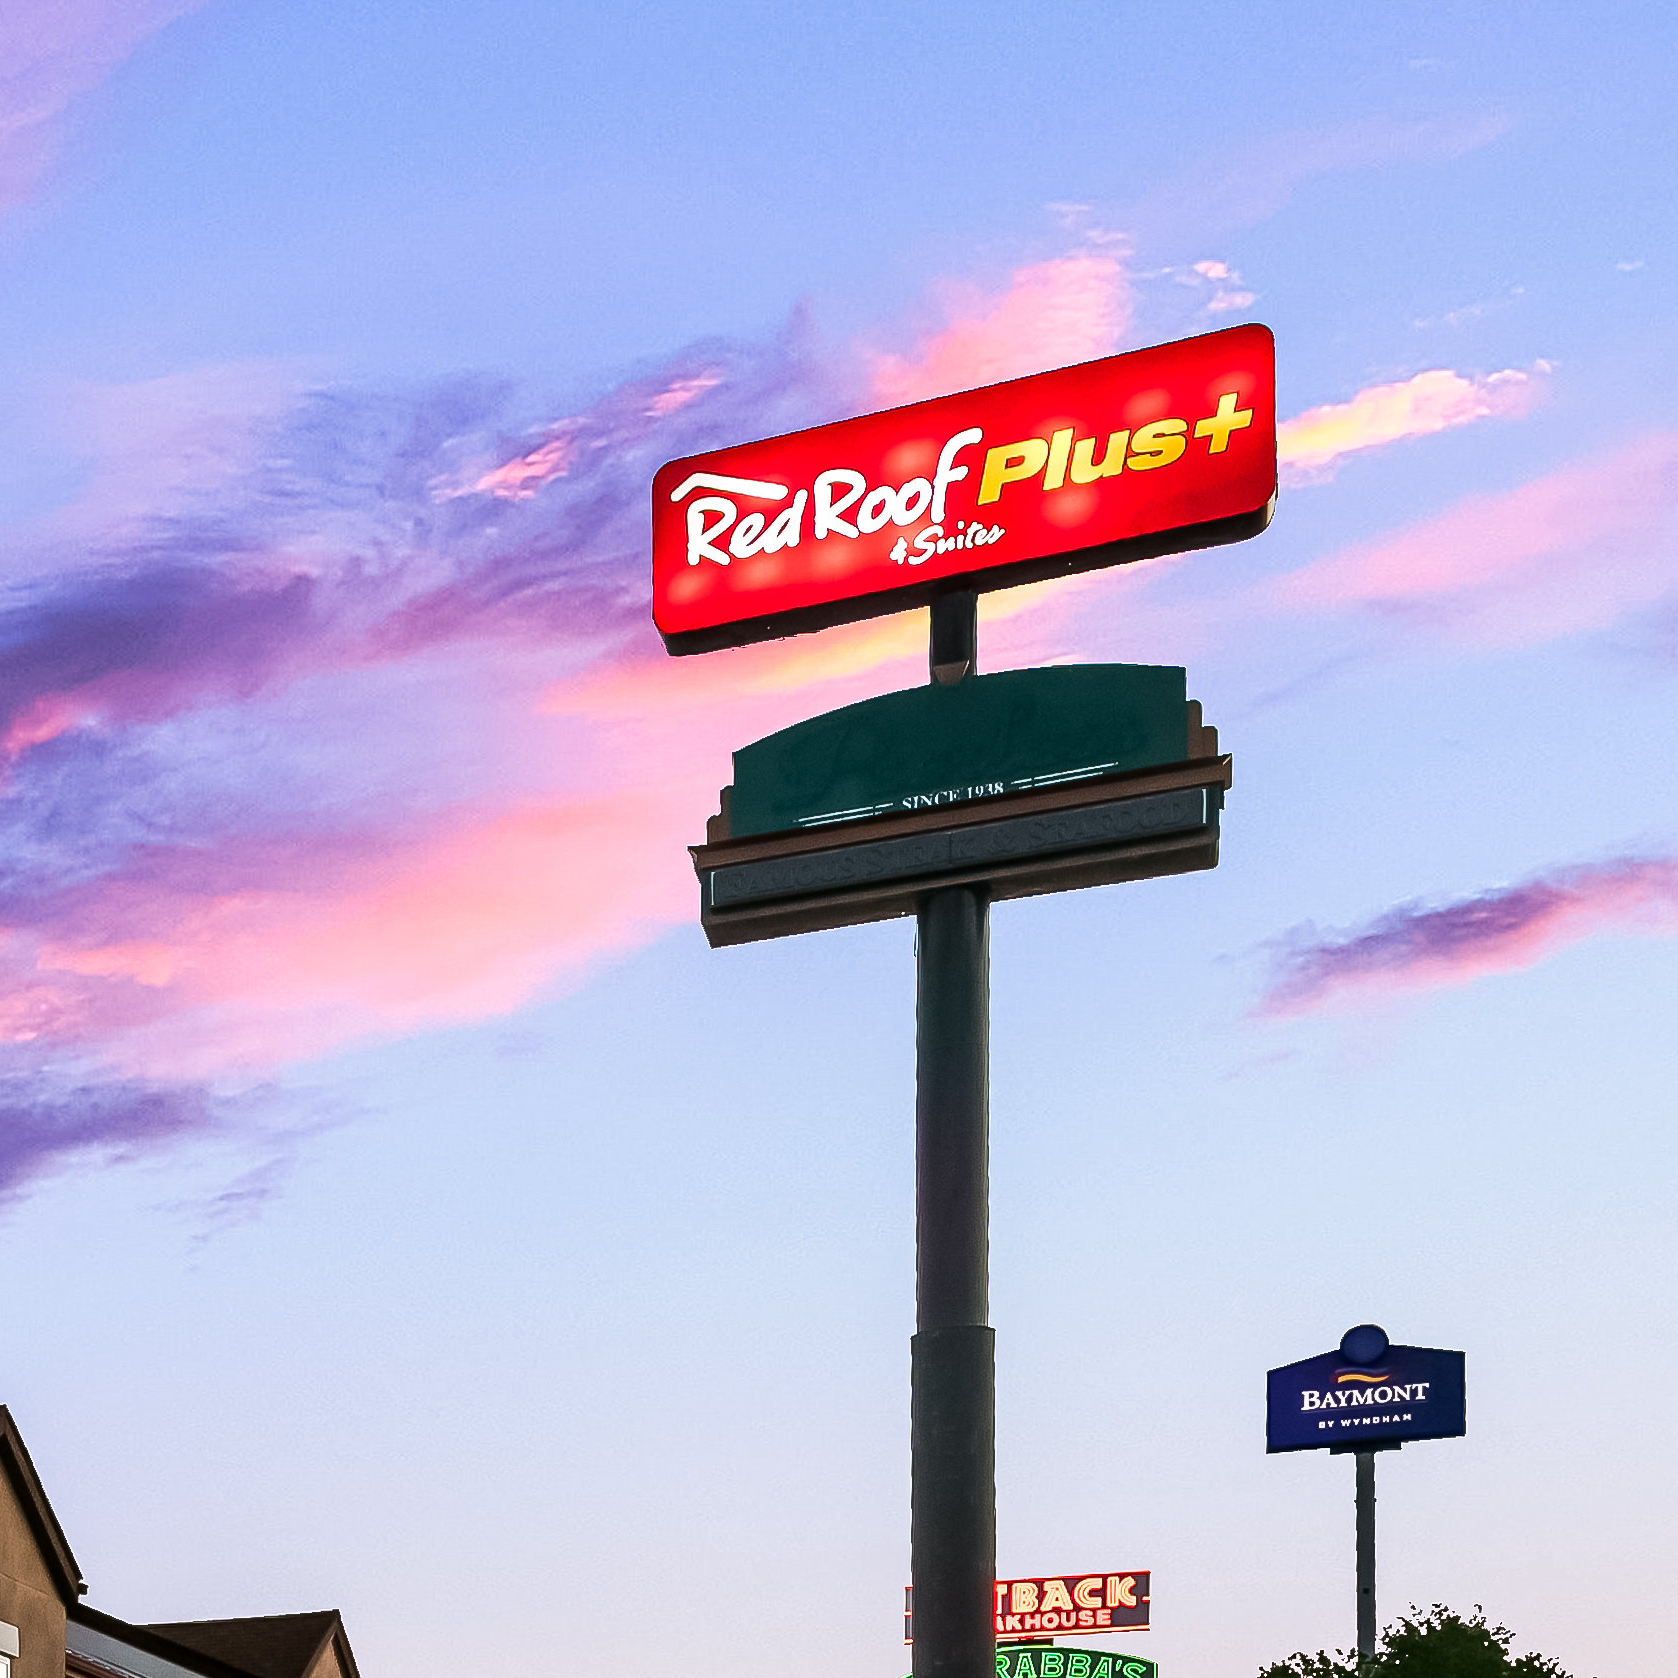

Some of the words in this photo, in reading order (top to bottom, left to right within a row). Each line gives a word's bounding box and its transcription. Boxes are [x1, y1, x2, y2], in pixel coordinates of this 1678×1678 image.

[686, 488, 808, 567] Red
[813, 428, 983, 540] Roof
[967, 781, 1004, 799] 1938
[1300, 1382, 1430, 1411] BAYMONT
[1318, 1420, 1335, 1429] BY
[1340, 1413, 1412, 1427] WYNDHAM
[995, 1575, 1137, 1615] TBACK
[995, 1609, 1111, 1632] KHOUSE
